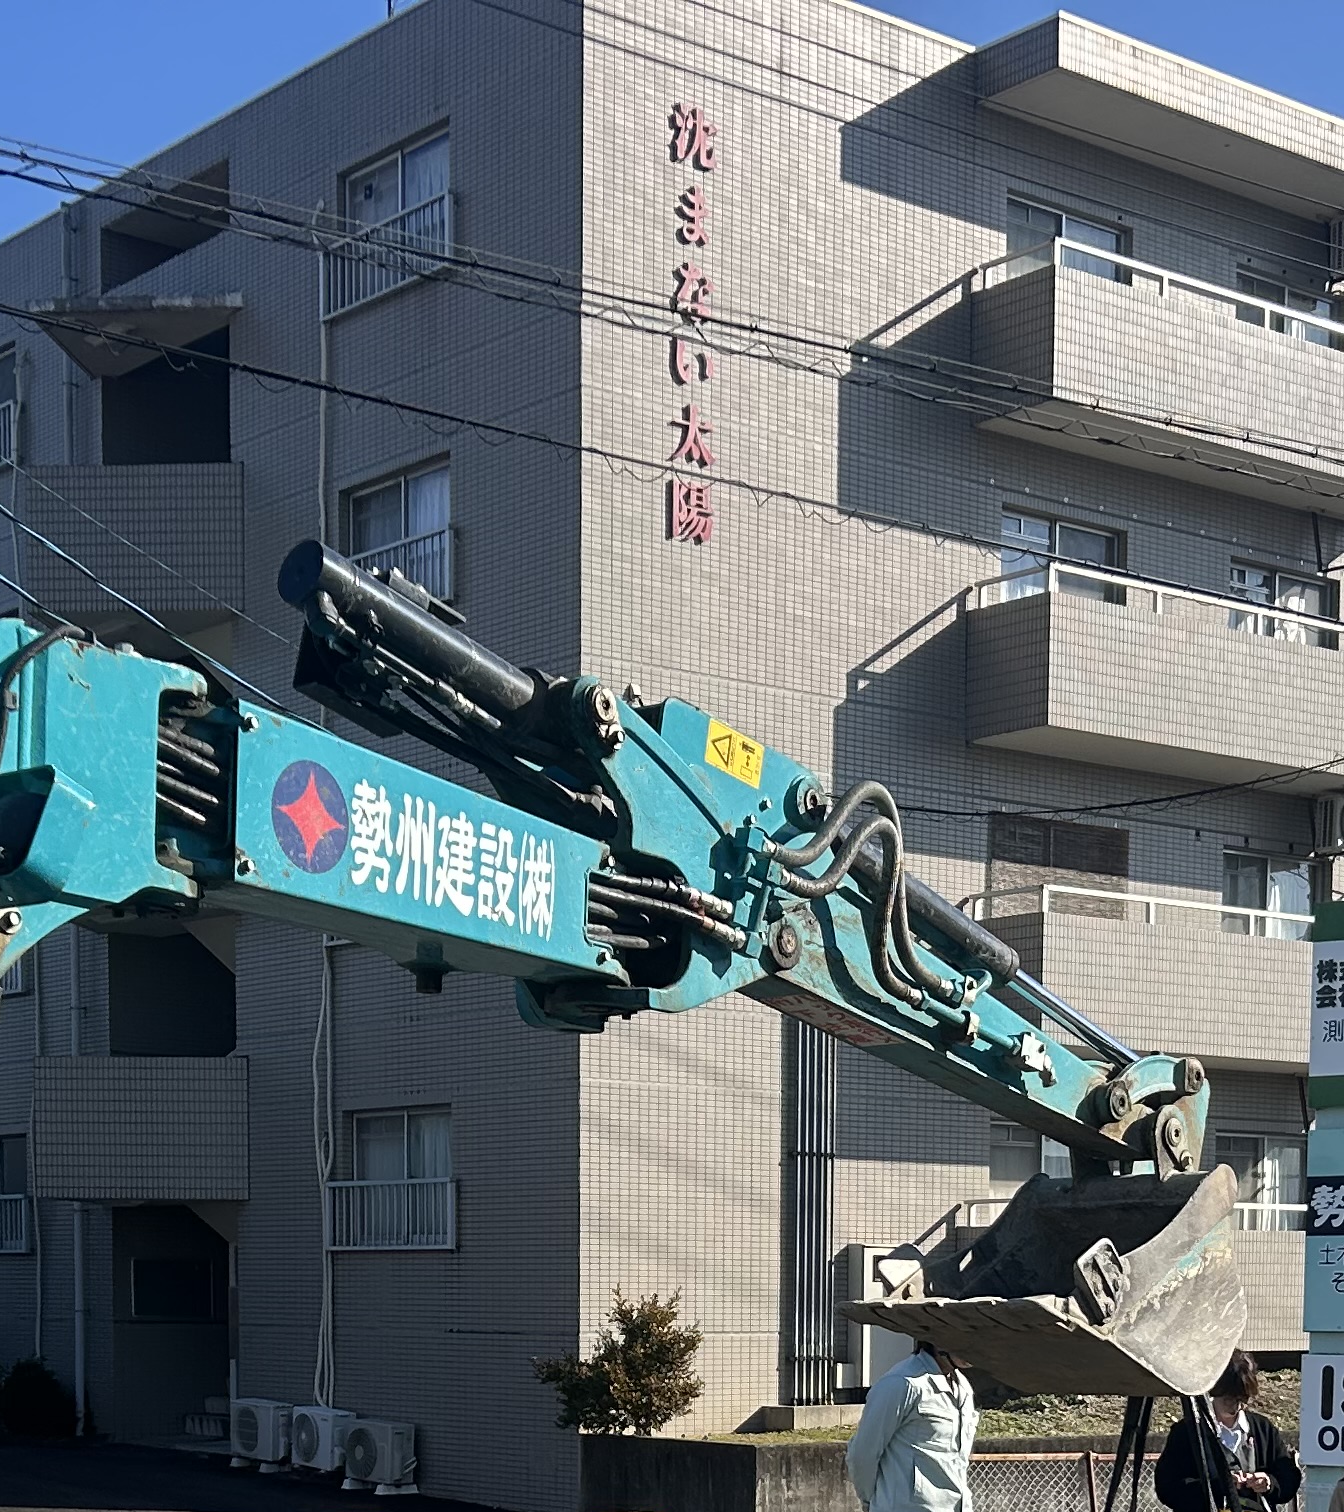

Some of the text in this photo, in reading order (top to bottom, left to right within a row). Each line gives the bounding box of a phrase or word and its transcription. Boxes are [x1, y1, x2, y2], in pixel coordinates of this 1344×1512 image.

[666, 101, 718, 545] 沈まない太陽
